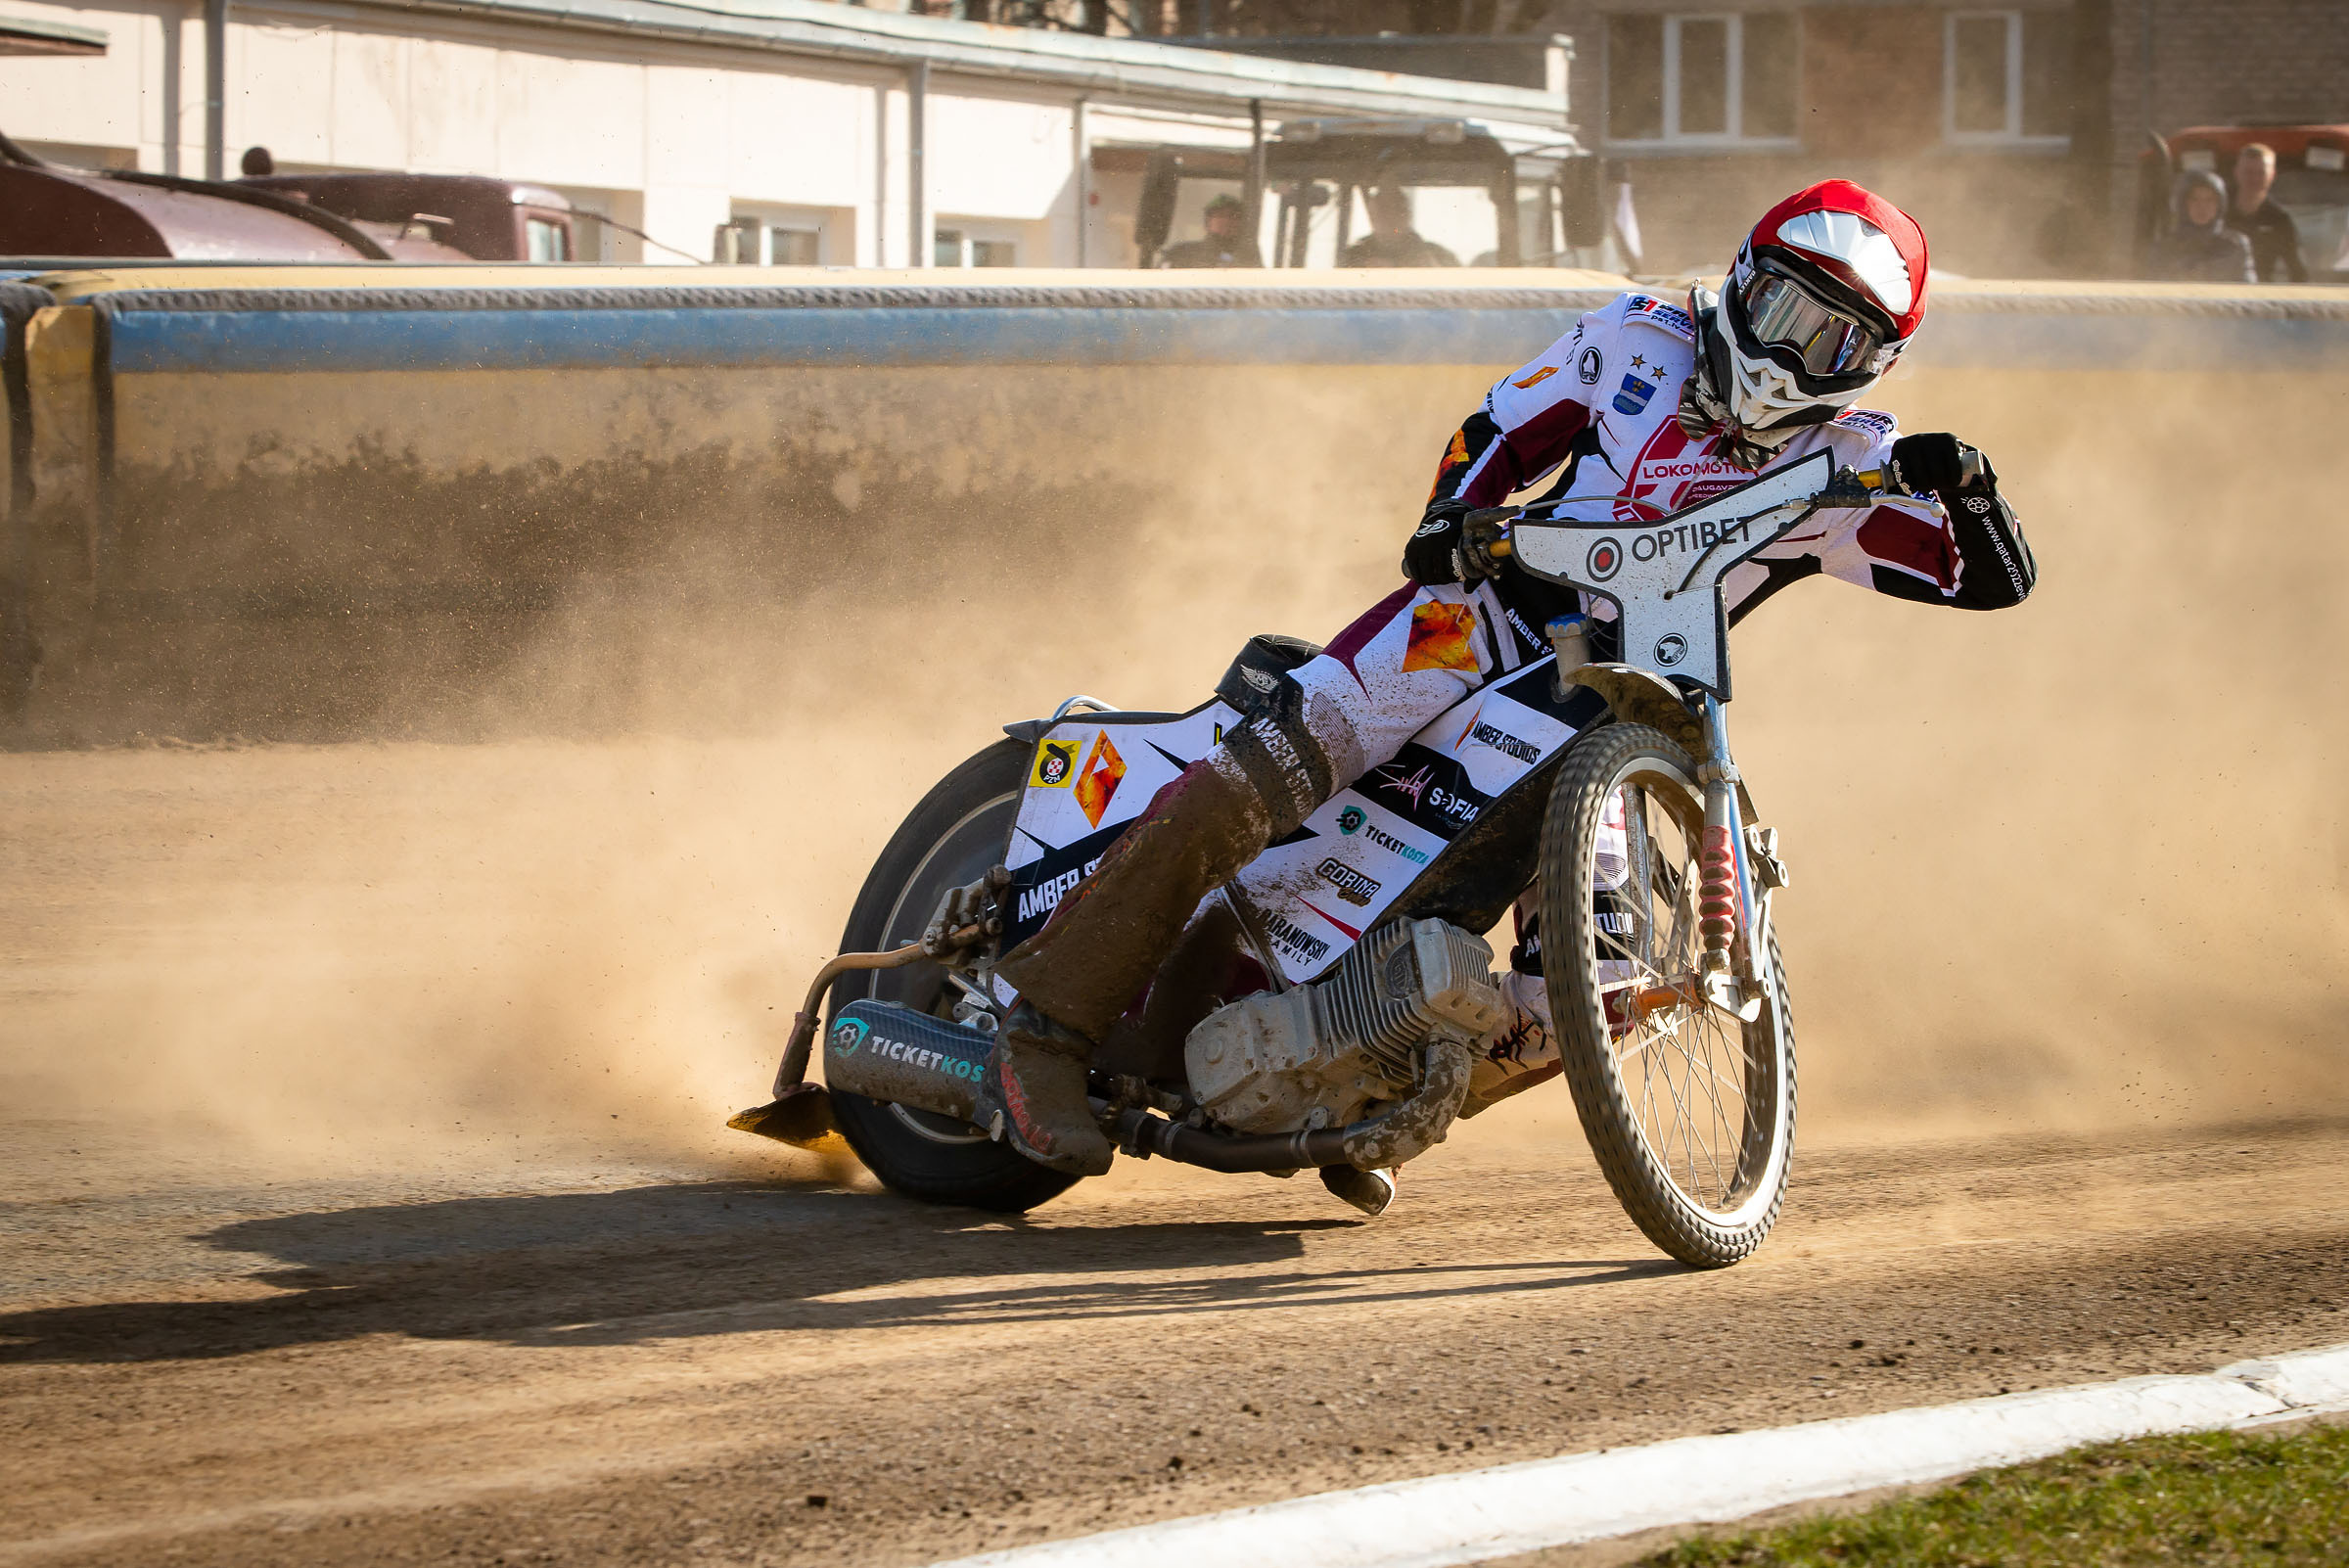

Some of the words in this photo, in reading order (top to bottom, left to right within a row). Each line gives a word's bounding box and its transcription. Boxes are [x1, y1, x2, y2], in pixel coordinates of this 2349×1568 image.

[1738, 269, 1756, 296] OAKLEY
[1632, 516, 1750, 562] OPTIBET
[1505, 608, 1542, 650] AMBER
[1471, 720, 1503, 746] AMBER
[1496, 734, 1542, 764] STUDIOS
[1043, 774, 1061, 784] PZM
[1365, 824, 1430, 864] TICKETKOSTA
